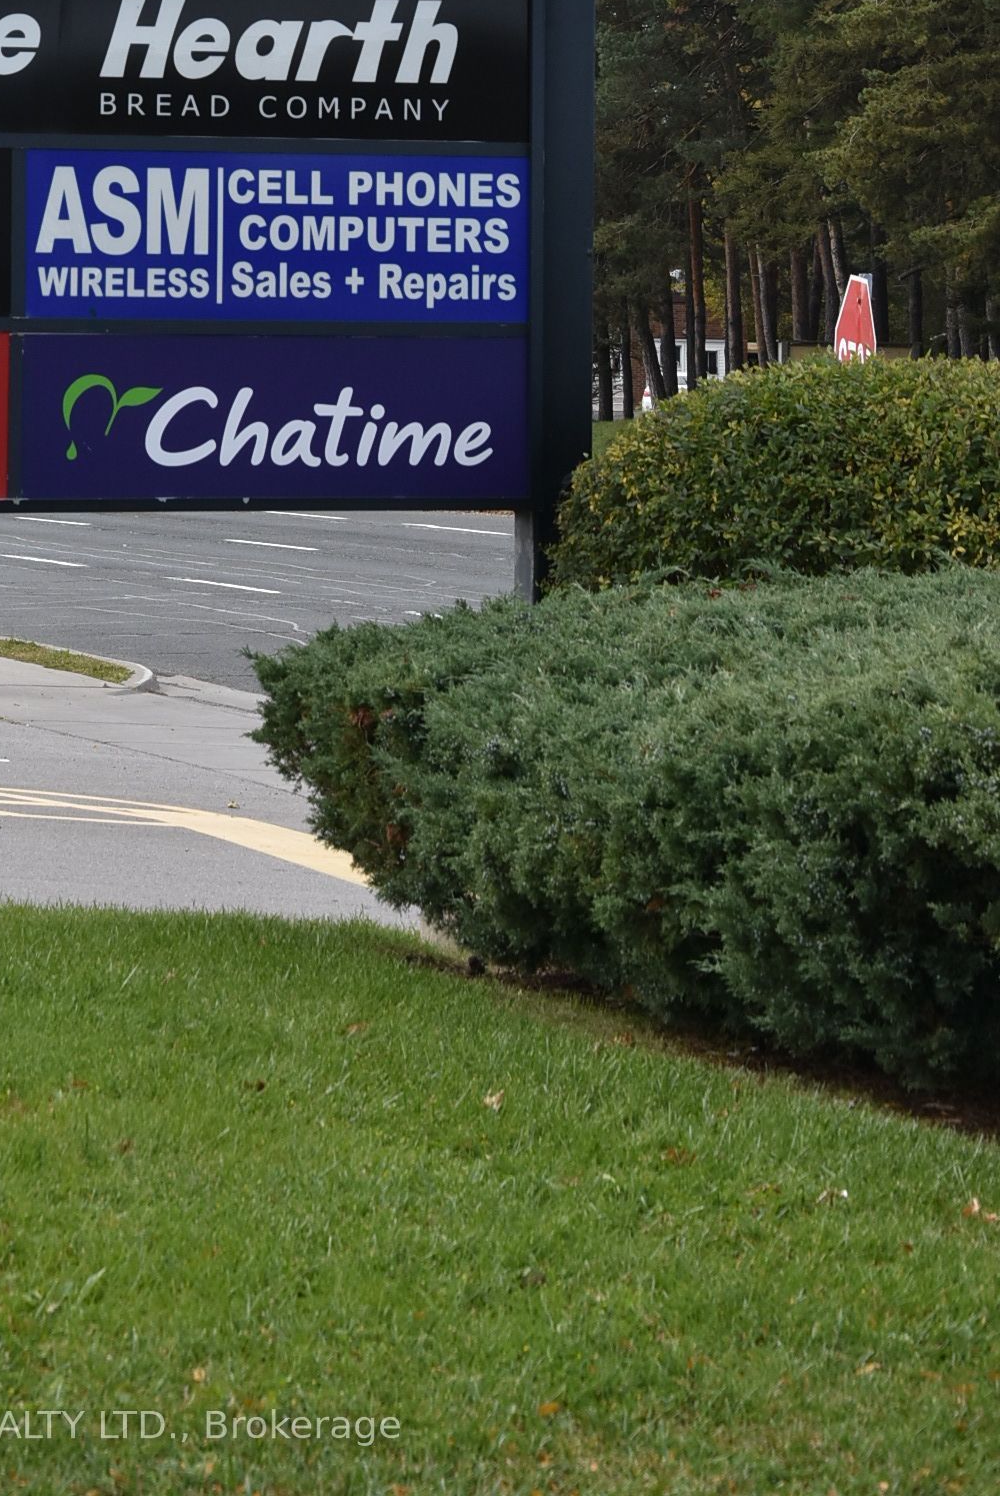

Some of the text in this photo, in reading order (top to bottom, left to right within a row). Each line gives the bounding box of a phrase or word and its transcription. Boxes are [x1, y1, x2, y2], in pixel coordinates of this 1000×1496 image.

[101, 93, 450, 122] BREAD COMPANY
[229, 169, 520, 208] CELL PHONES
[36, 166, 210, 256] ASM
[240, 215, 510, 254] COMPUTERS
[39, 267, 210, 299] WIRELESS
[232, 262, 517, 309] Sales + Repairs
[145, 387, 493, 467] Chatime
